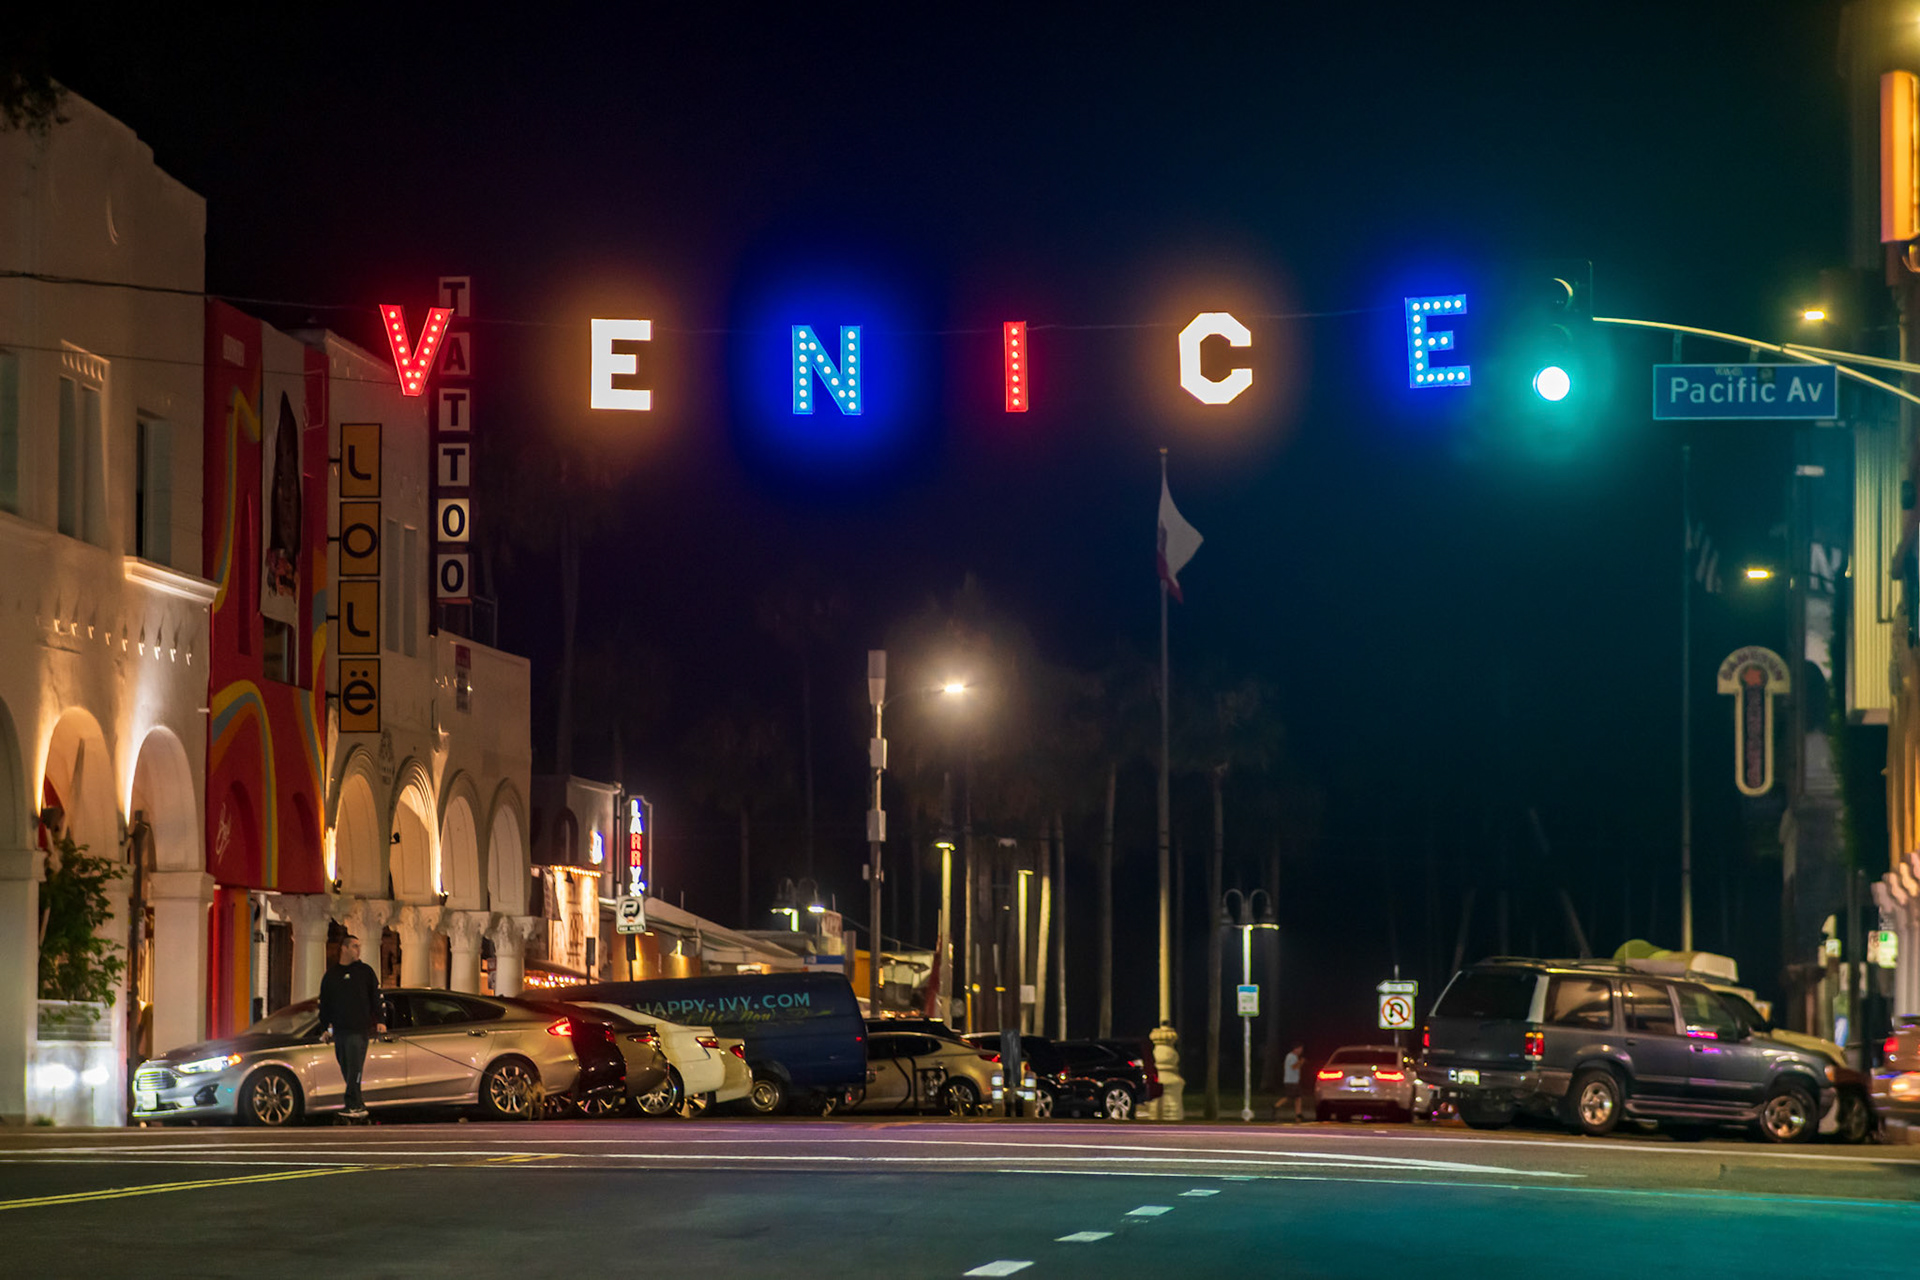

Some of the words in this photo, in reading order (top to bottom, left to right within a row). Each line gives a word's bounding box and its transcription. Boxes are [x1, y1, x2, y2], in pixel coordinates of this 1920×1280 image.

[379, 294, 1471, 415] VENICE
[1670, 375, 1776, 404] Pacific
[1786, 376, 1824, 404] Av
[440, 281, 467, 594] TATTOO
[636, 992, 811, 1016] HAPPY-IVY.COM
